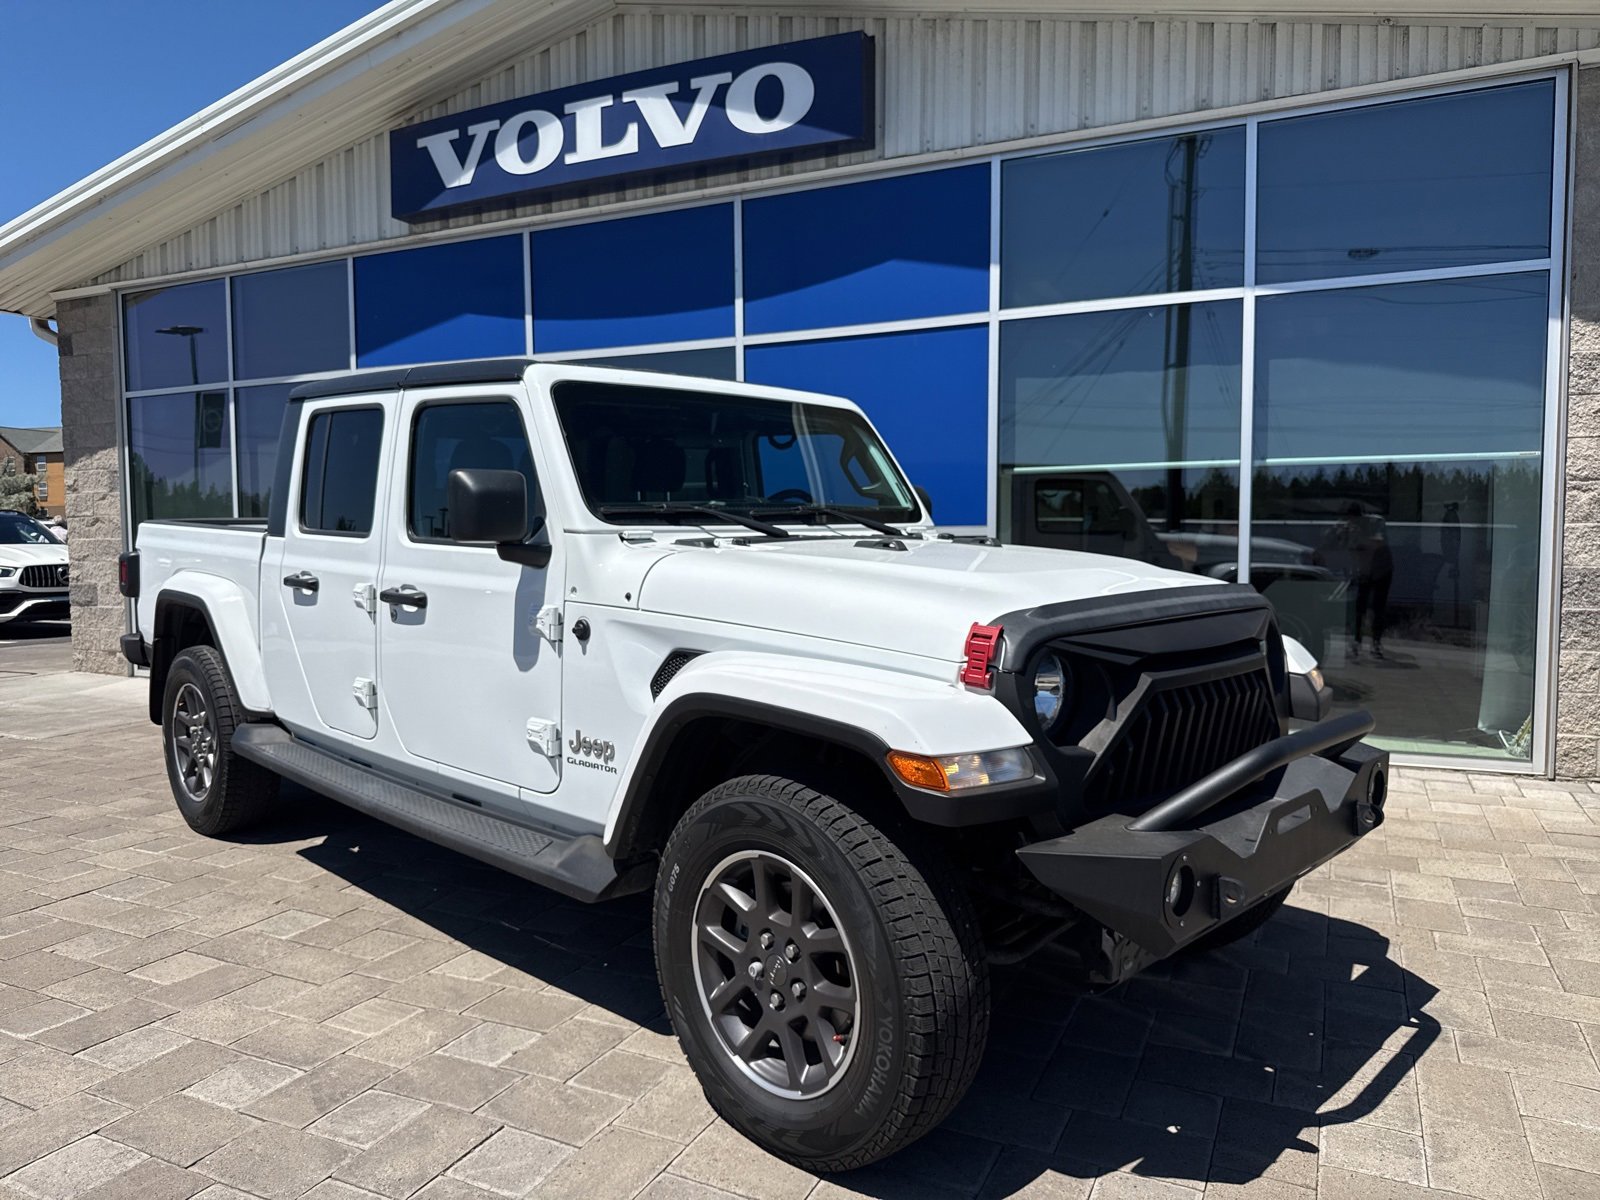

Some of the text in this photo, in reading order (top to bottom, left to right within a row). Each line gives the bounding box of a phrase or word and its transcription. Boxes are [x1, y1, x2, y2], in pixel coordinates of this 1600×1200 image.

[416, 61, 815, 189] VOLVO
[566, 756, 618, 775] GLADIATOR
[568, 729, 616, 766] Jeep
[854, 1016, 893, 1118] YOKOHAMA
